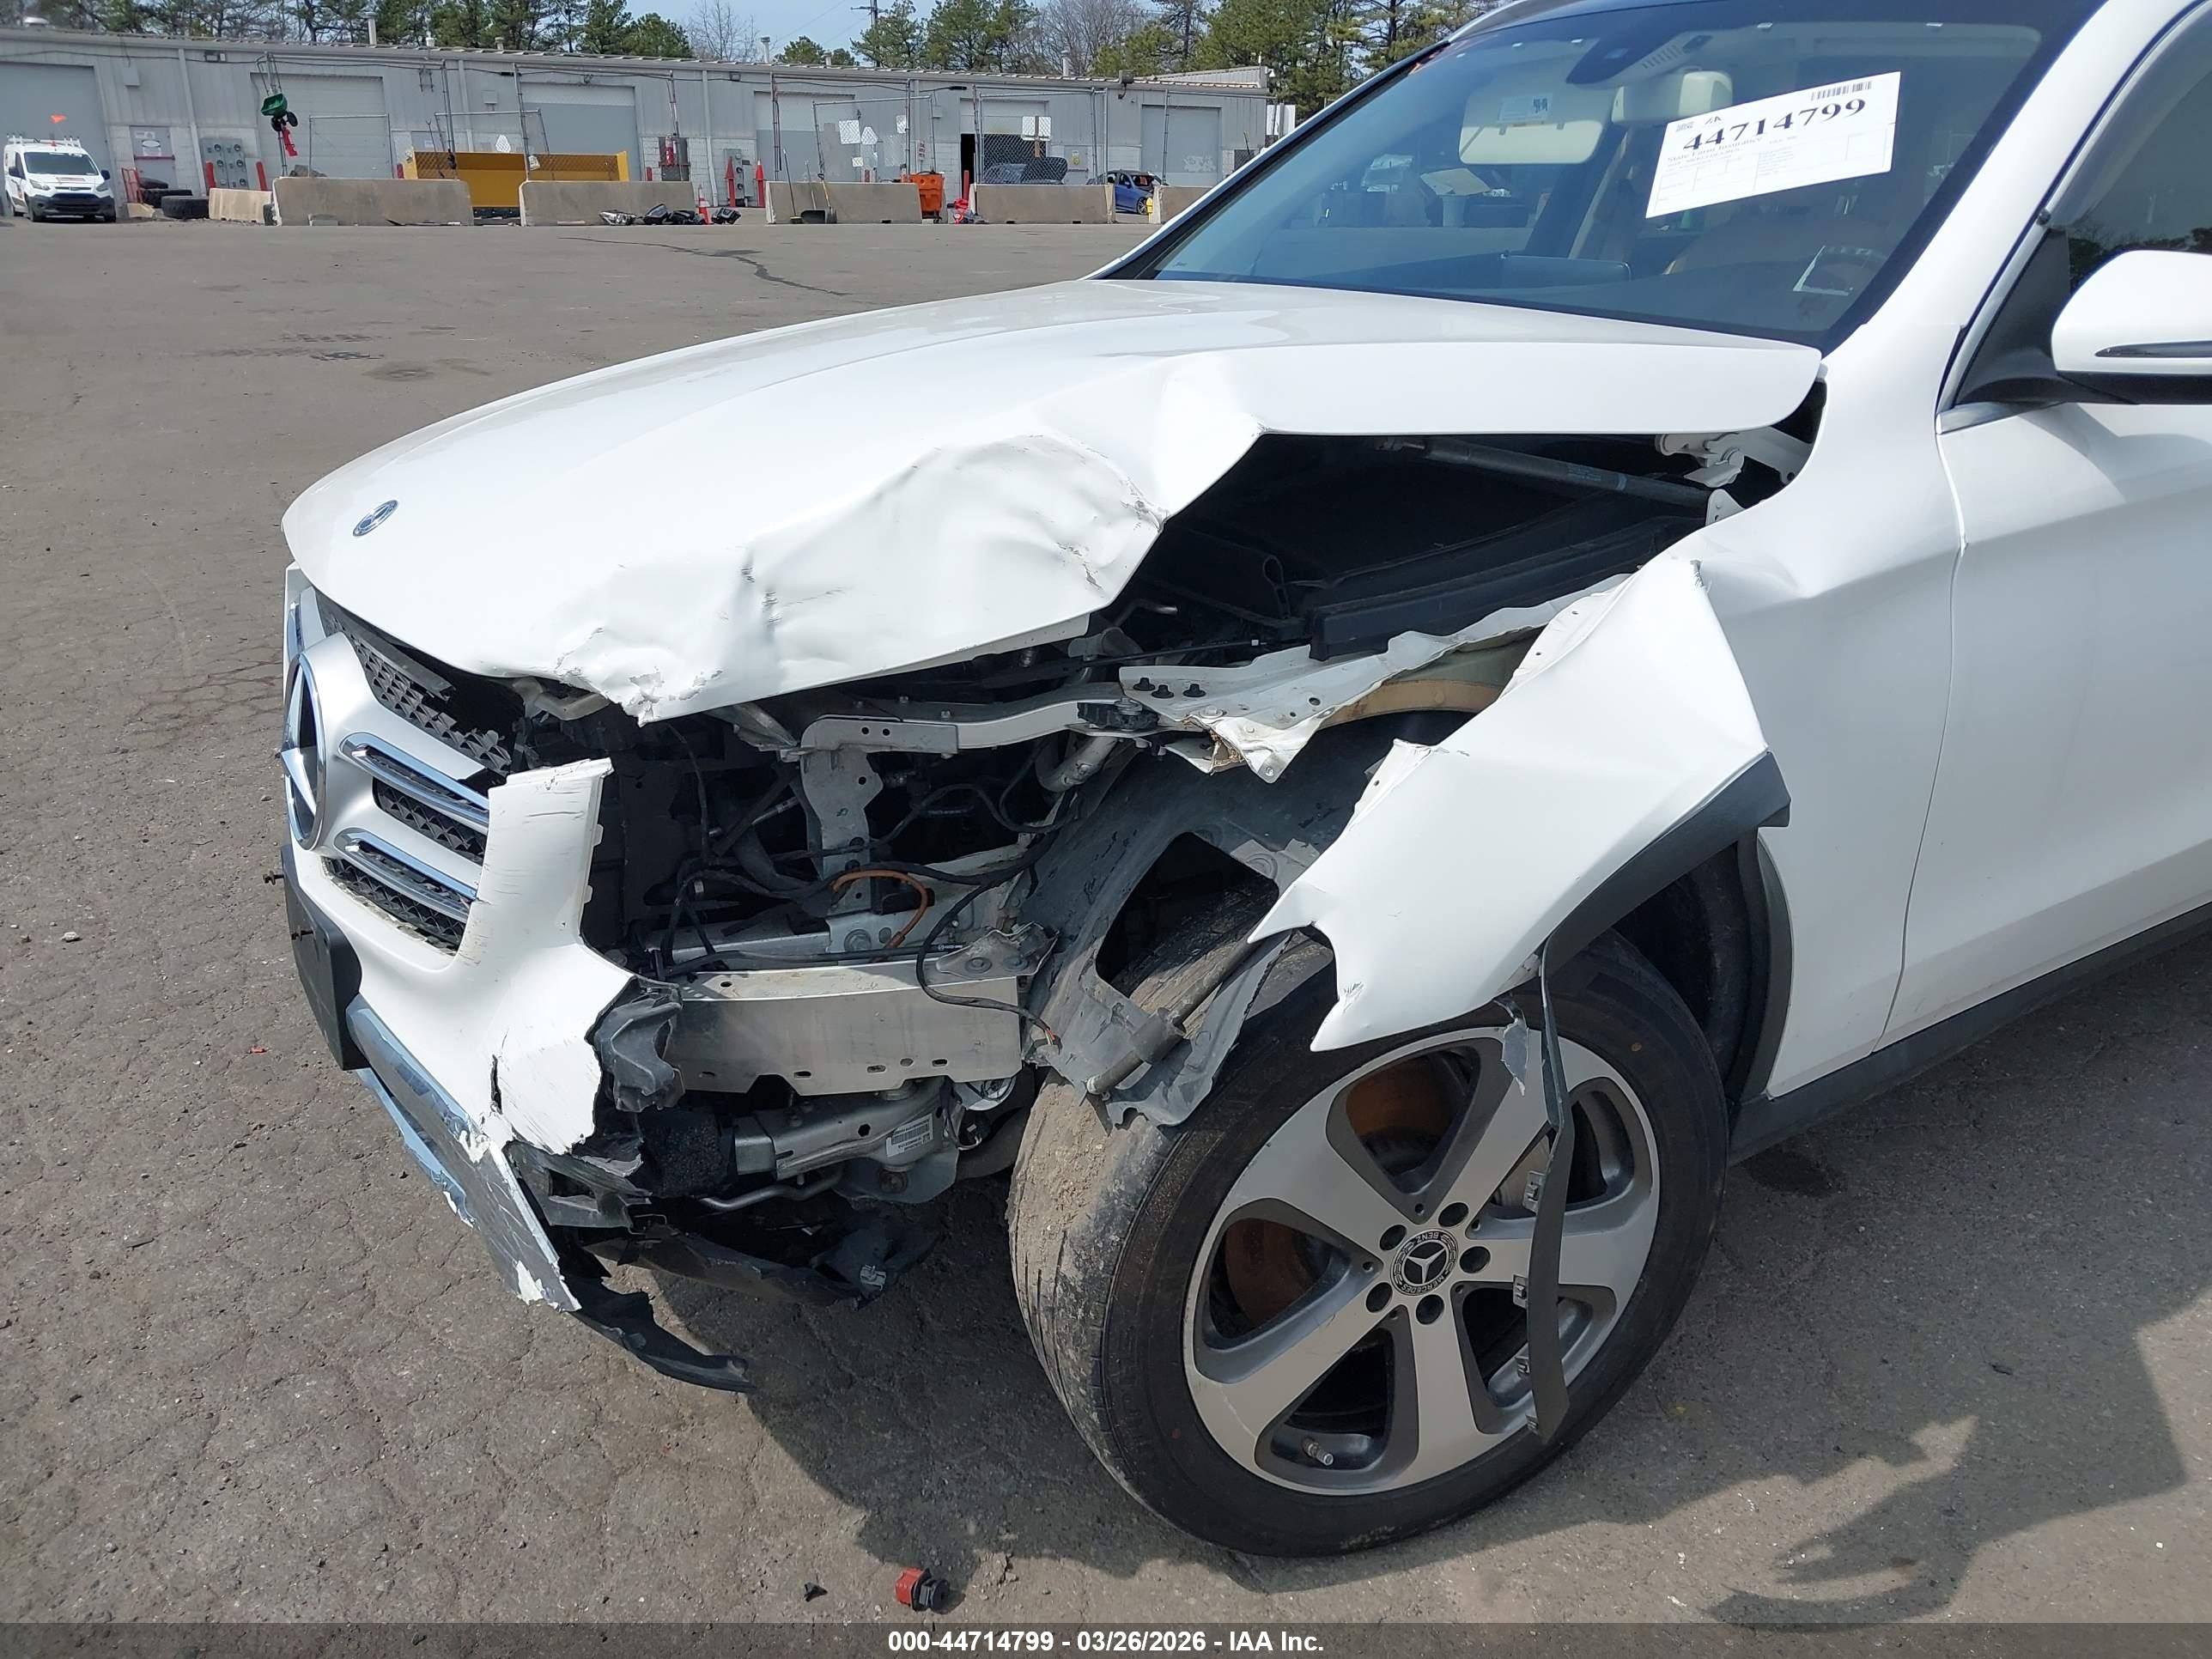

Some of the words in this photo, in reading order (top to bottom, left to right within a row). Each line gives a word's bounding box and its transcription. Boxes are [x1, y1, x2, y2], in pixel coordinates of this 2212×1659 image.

[1682, 98, 1866, 150] 44714799
[1415, 1231, 1440, 1243] BENZ
[1401, 1274, 1445, 1294] MERCEDES
